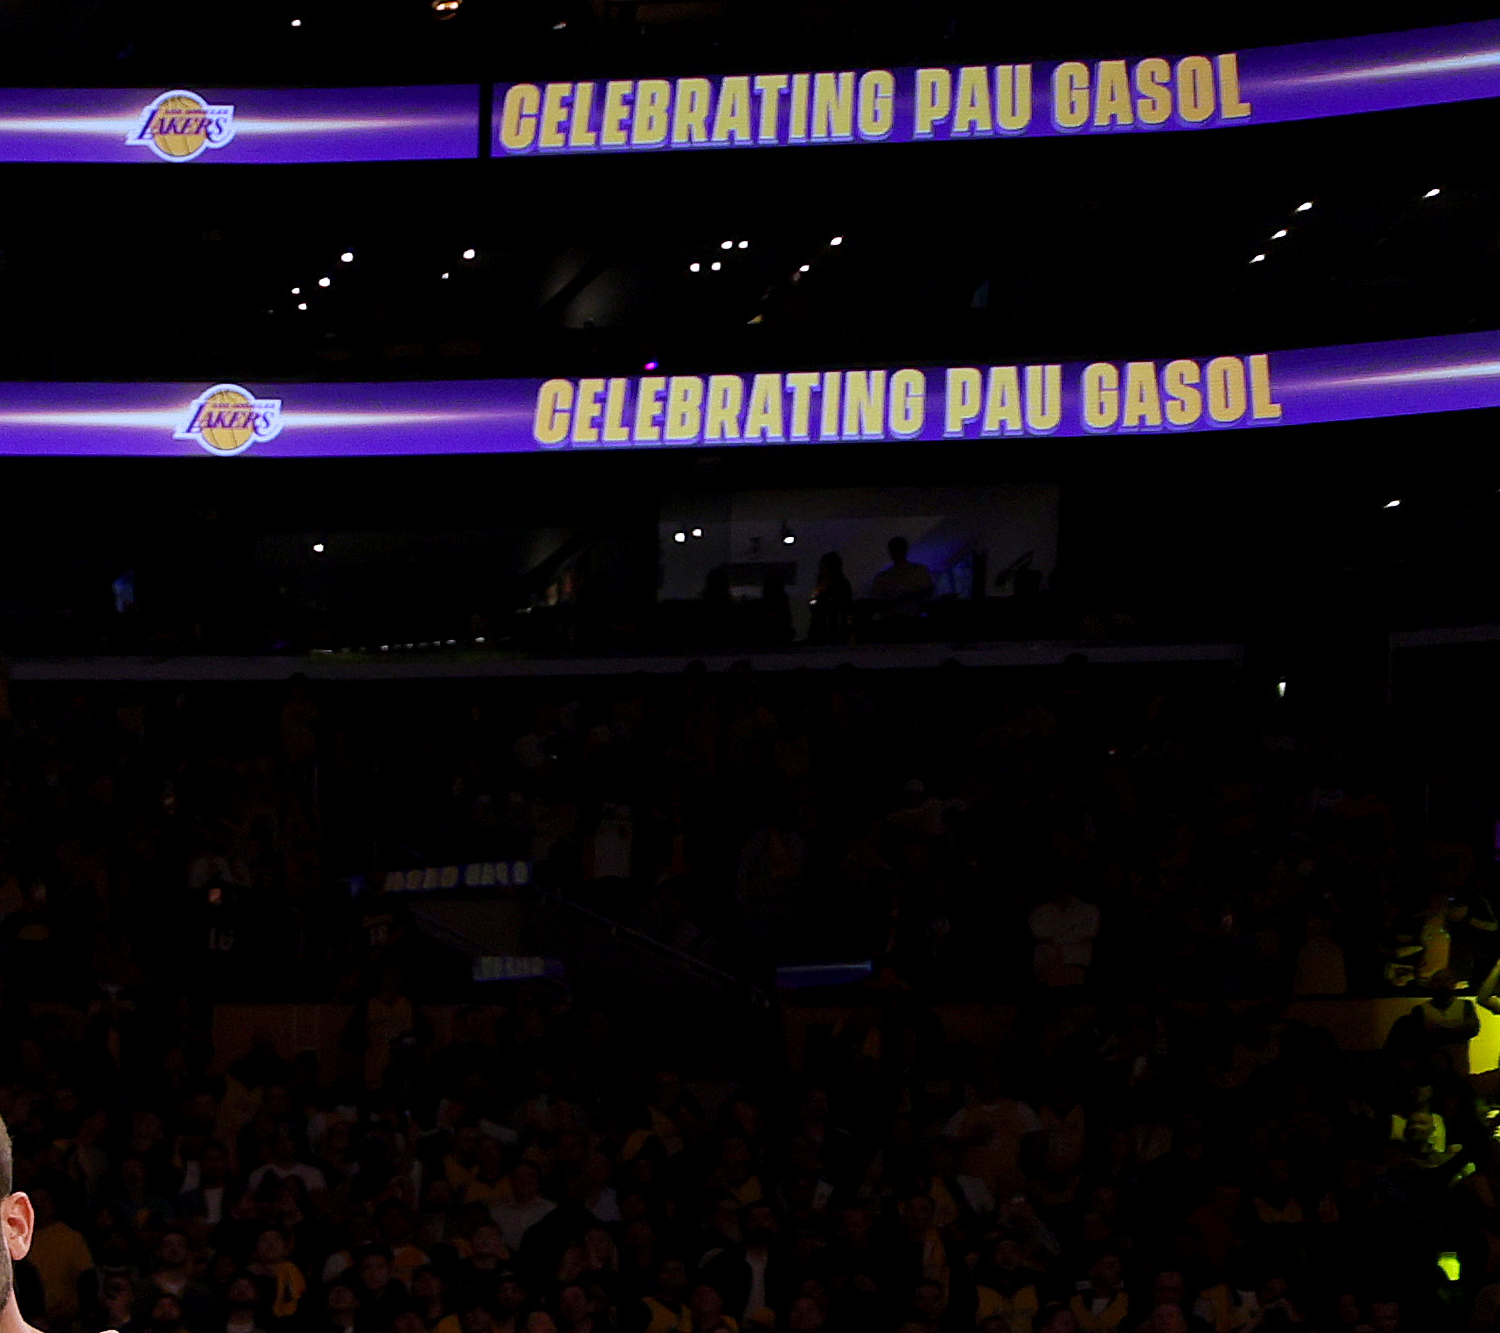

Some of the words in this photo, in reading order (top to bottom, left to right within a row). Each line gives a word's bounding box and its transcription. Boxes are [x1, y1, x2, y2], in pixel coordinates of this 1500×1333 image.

[137, 109, 229, 142] LAKERS
[500, 68, 896, 151] CELEBRATING
[917, 63, 1034, 134] PAU
[1055, 51, 1253, 129] GASOL
[185, 403, 277, 436] LAKERS
[534, 367, 926, 445] CELEBRATING
[948, 363, 1063, 433] PAU
[1084, 353, 1284, 430] GASOL
